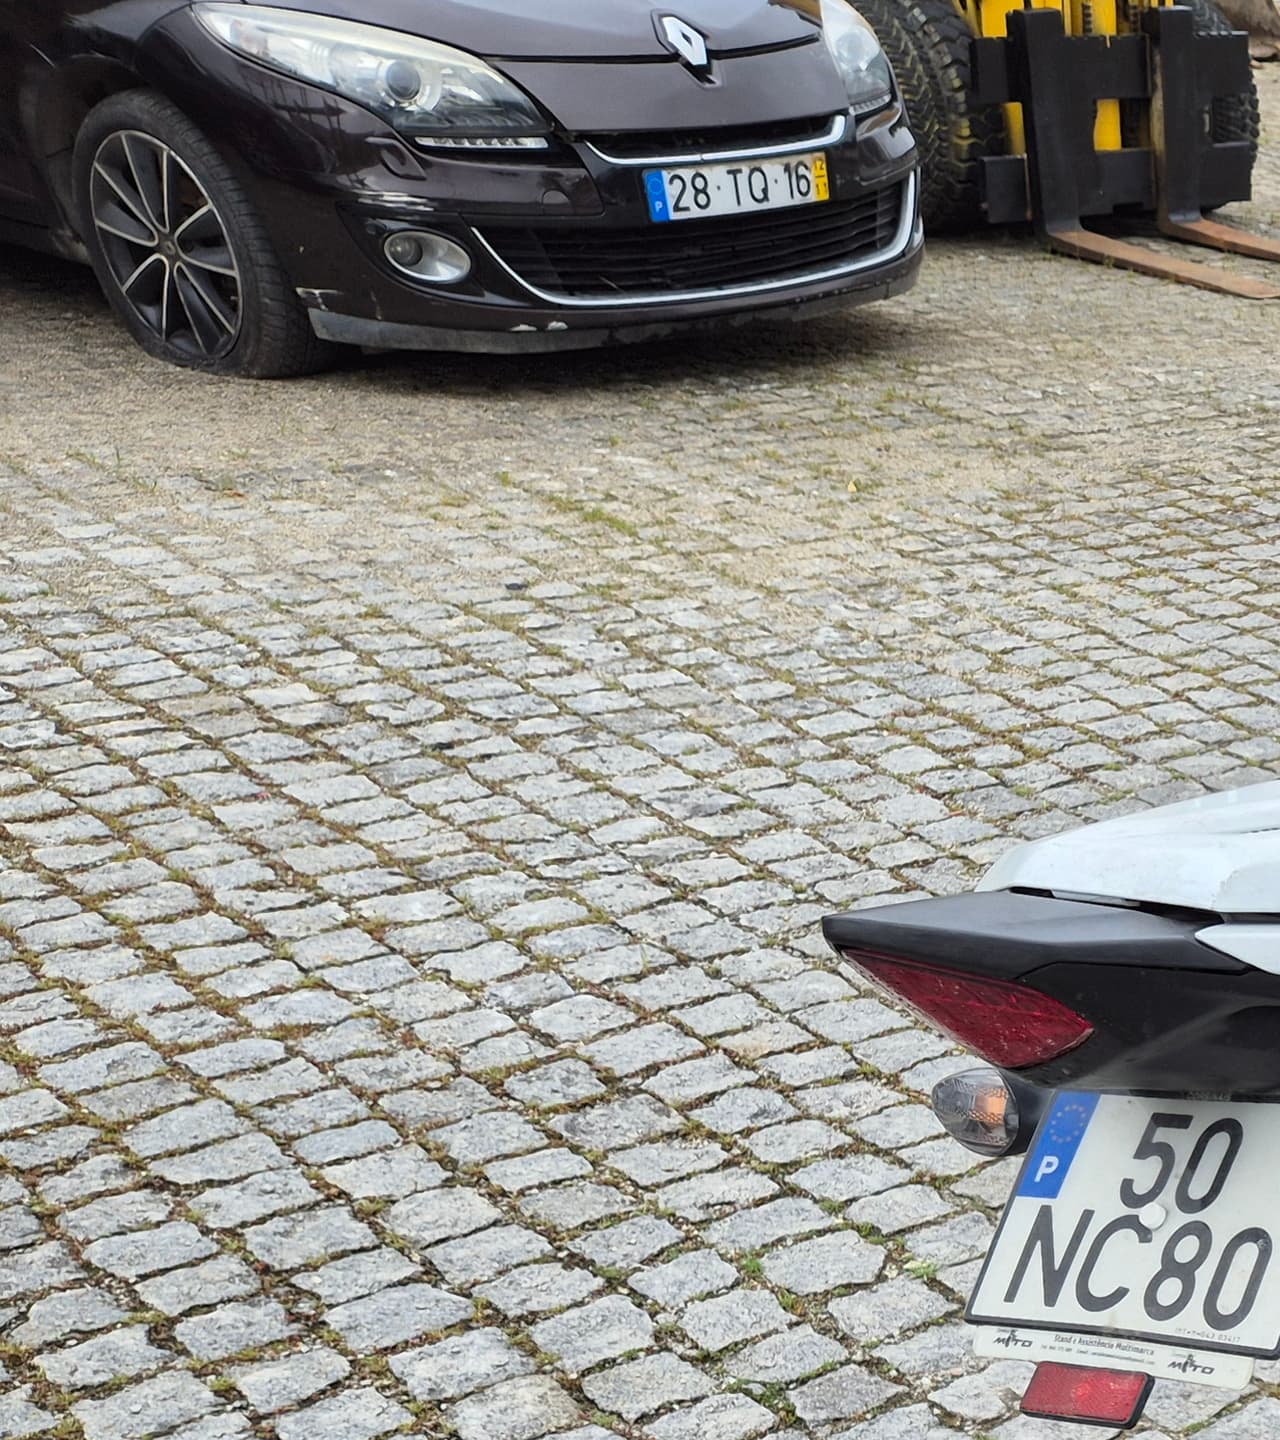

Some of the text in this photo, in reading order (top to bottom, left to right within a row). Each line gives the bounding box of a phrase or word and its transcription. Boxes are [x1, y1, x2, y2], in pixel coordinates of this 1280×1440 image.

[654, 200, 664, 213] P
[1034, 1155, 1060, 1183] P
[1119, 1113, 1244, 1214] 50
[1003, 1204, 1273, 1332] NC80
